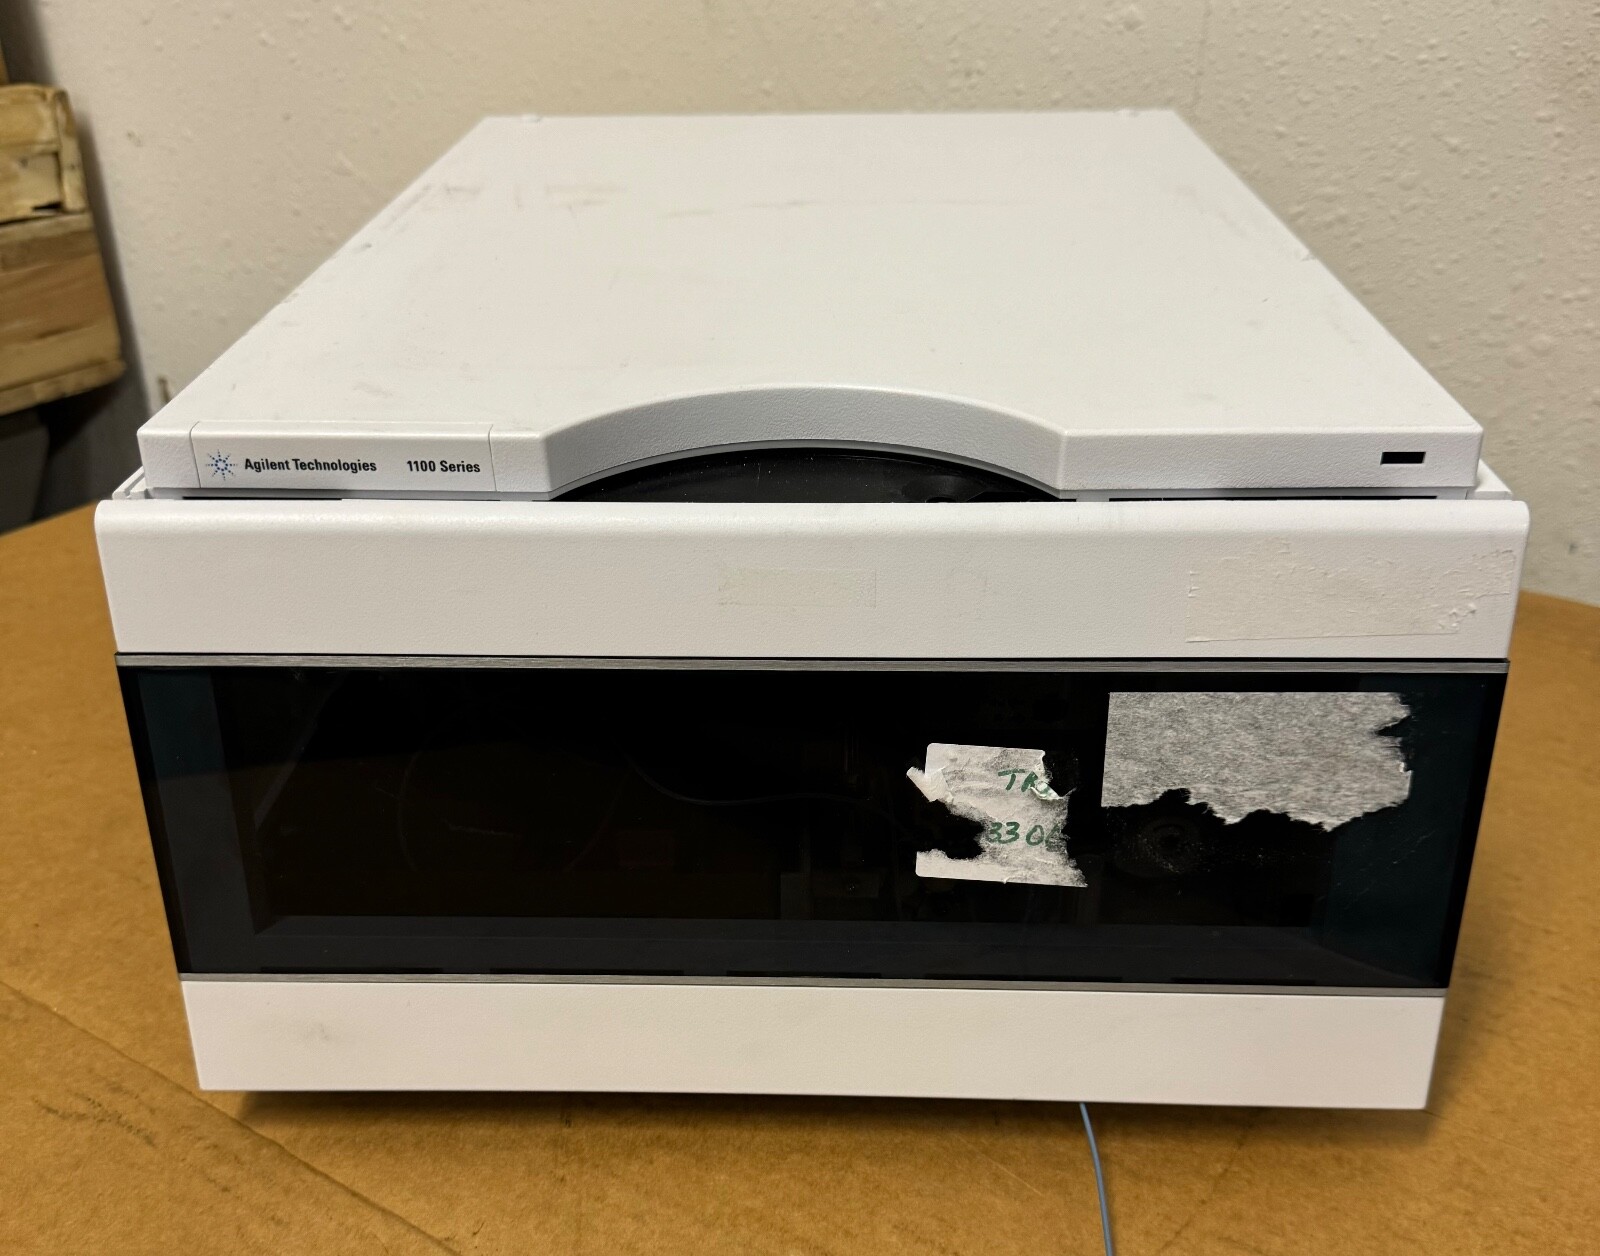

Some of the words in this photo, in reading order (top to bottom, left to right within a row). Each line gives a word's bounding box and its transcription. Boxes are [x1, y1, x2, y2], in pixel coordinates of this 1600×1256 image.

[244, 458, 292, 473] Agilent
[292, 459, 377, 474] Technologies
[406, 460, 437, 473] 1100
[440, 460, 481, 474] Series
